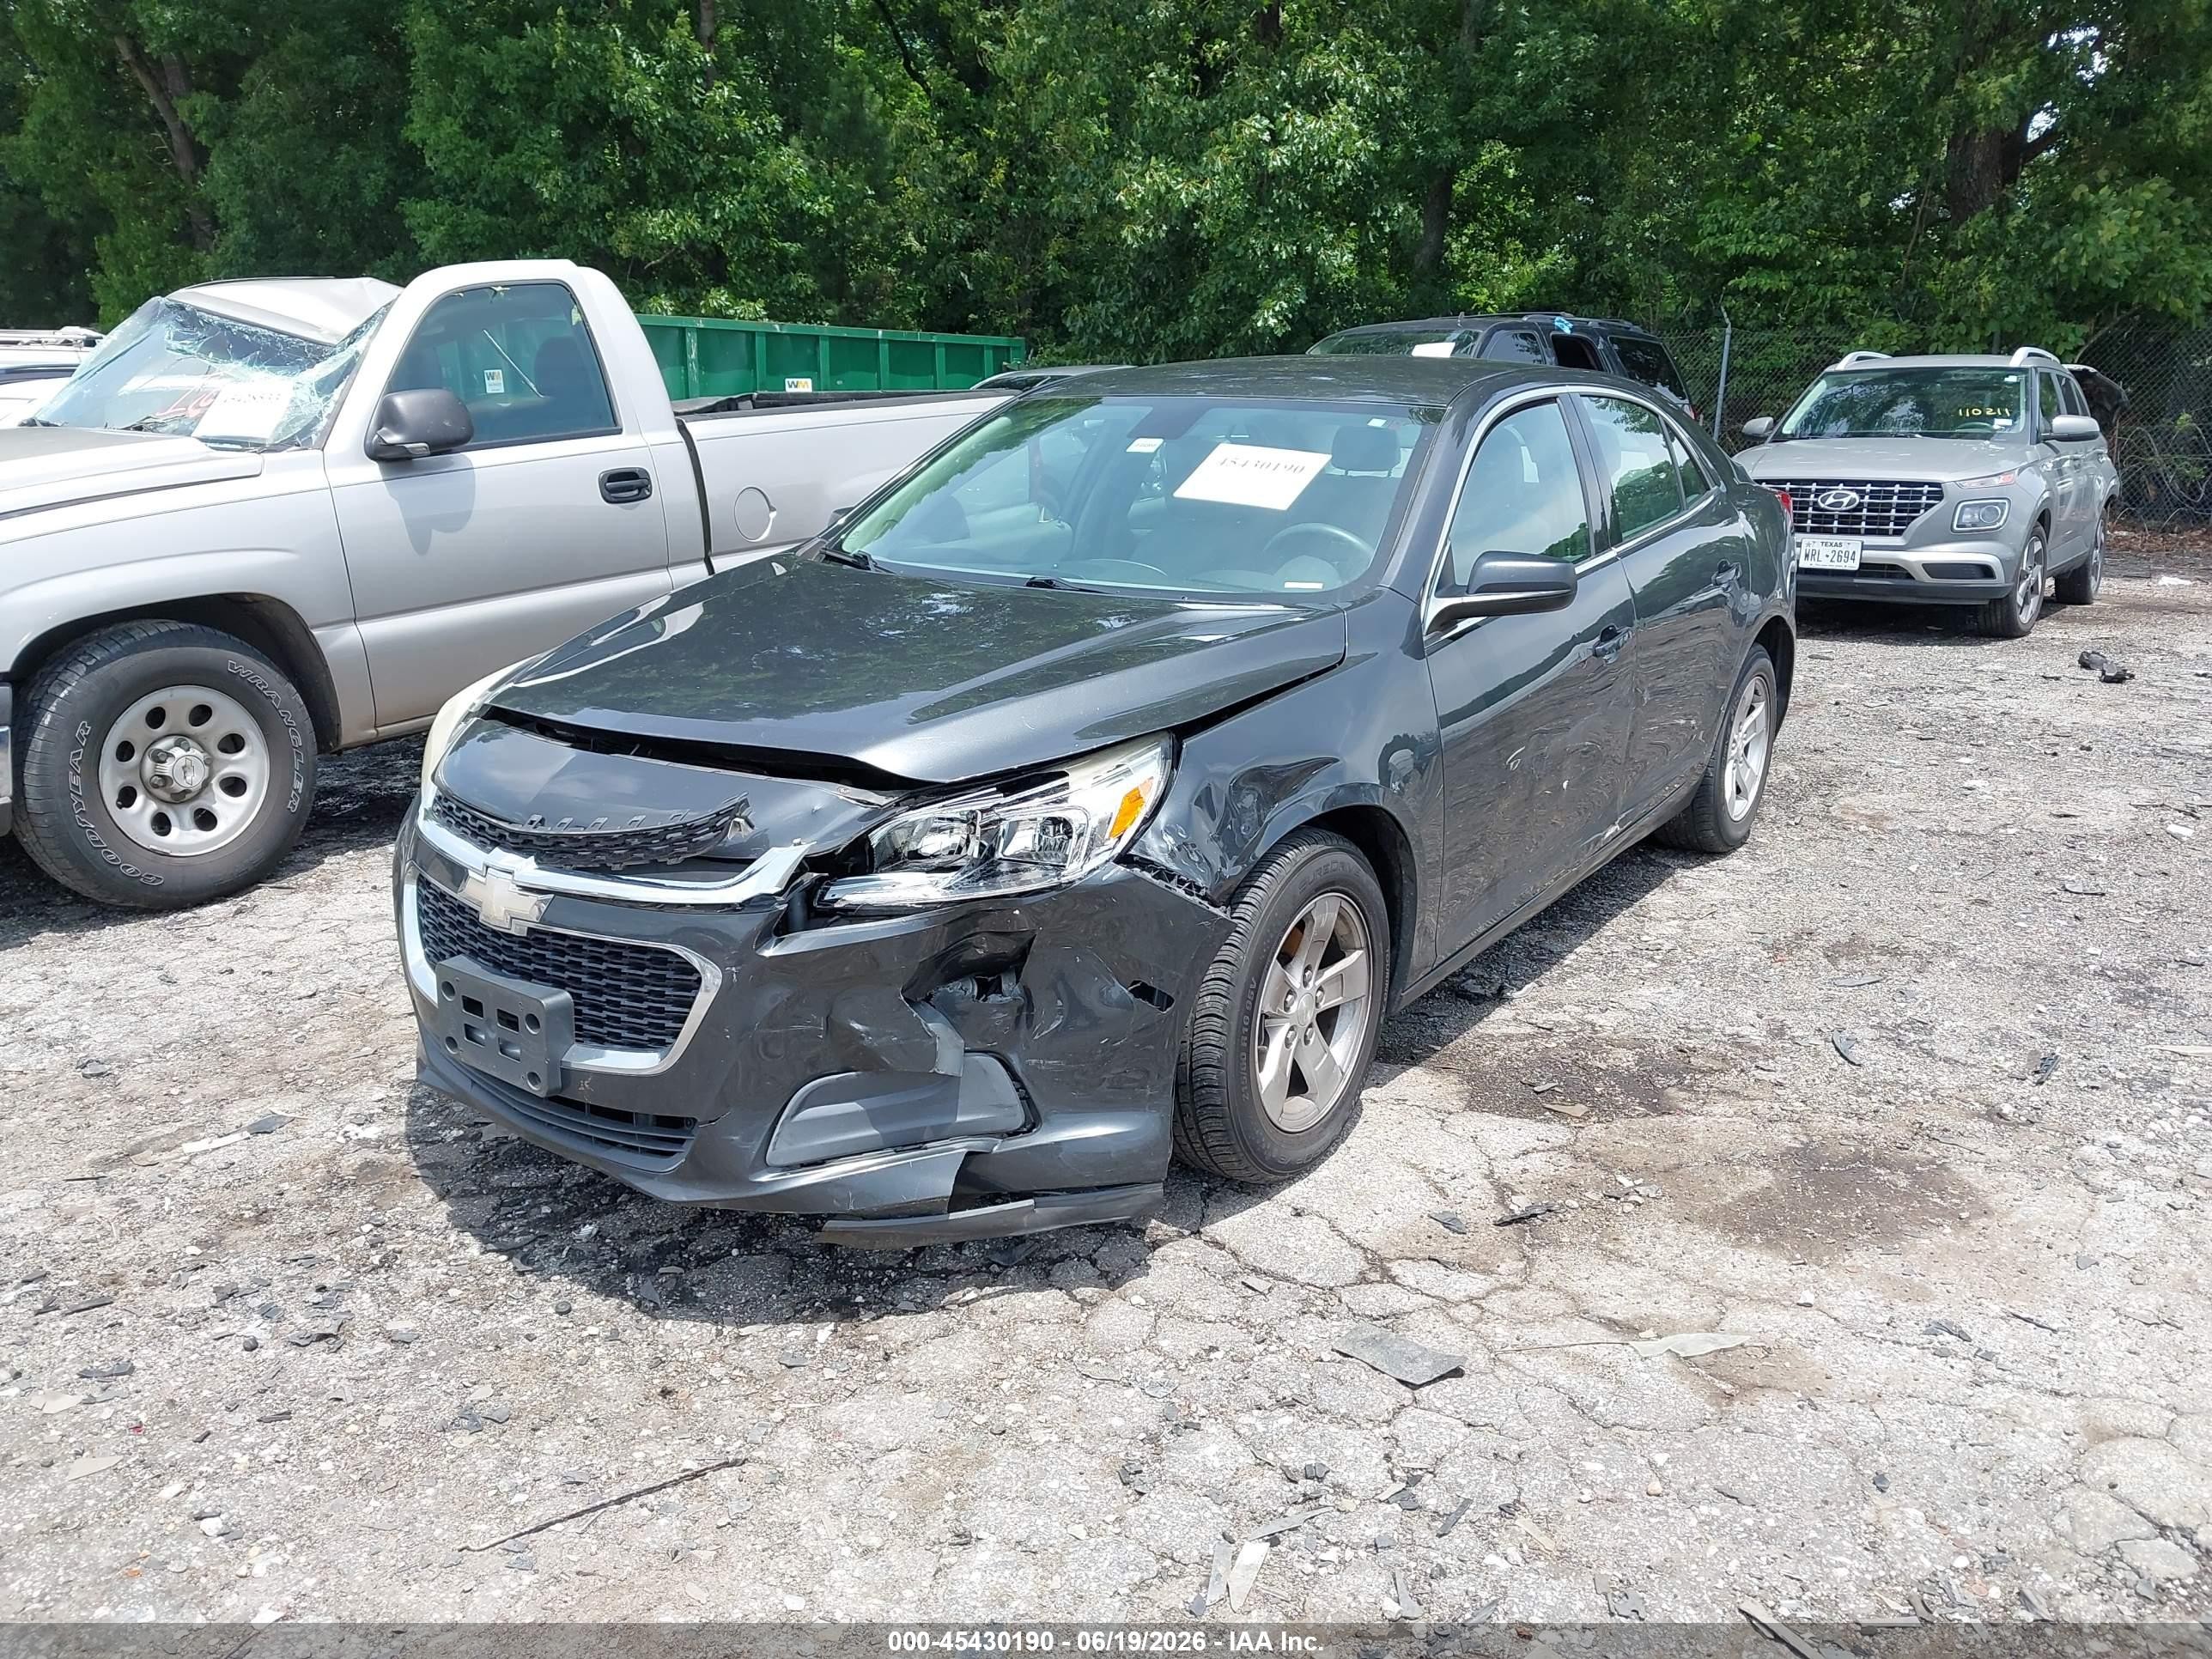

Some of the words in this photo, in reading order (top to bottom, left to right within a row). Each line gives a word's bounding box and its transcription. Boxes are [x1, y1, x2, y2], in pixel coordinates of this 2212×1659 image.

[1959, 407, 2011, 417] 110211
[1830, 550, 1856, 563] 2694
[228, 659, 305, 812] WRANGLER
[68, 720, 165, 885] GOODYEAR
